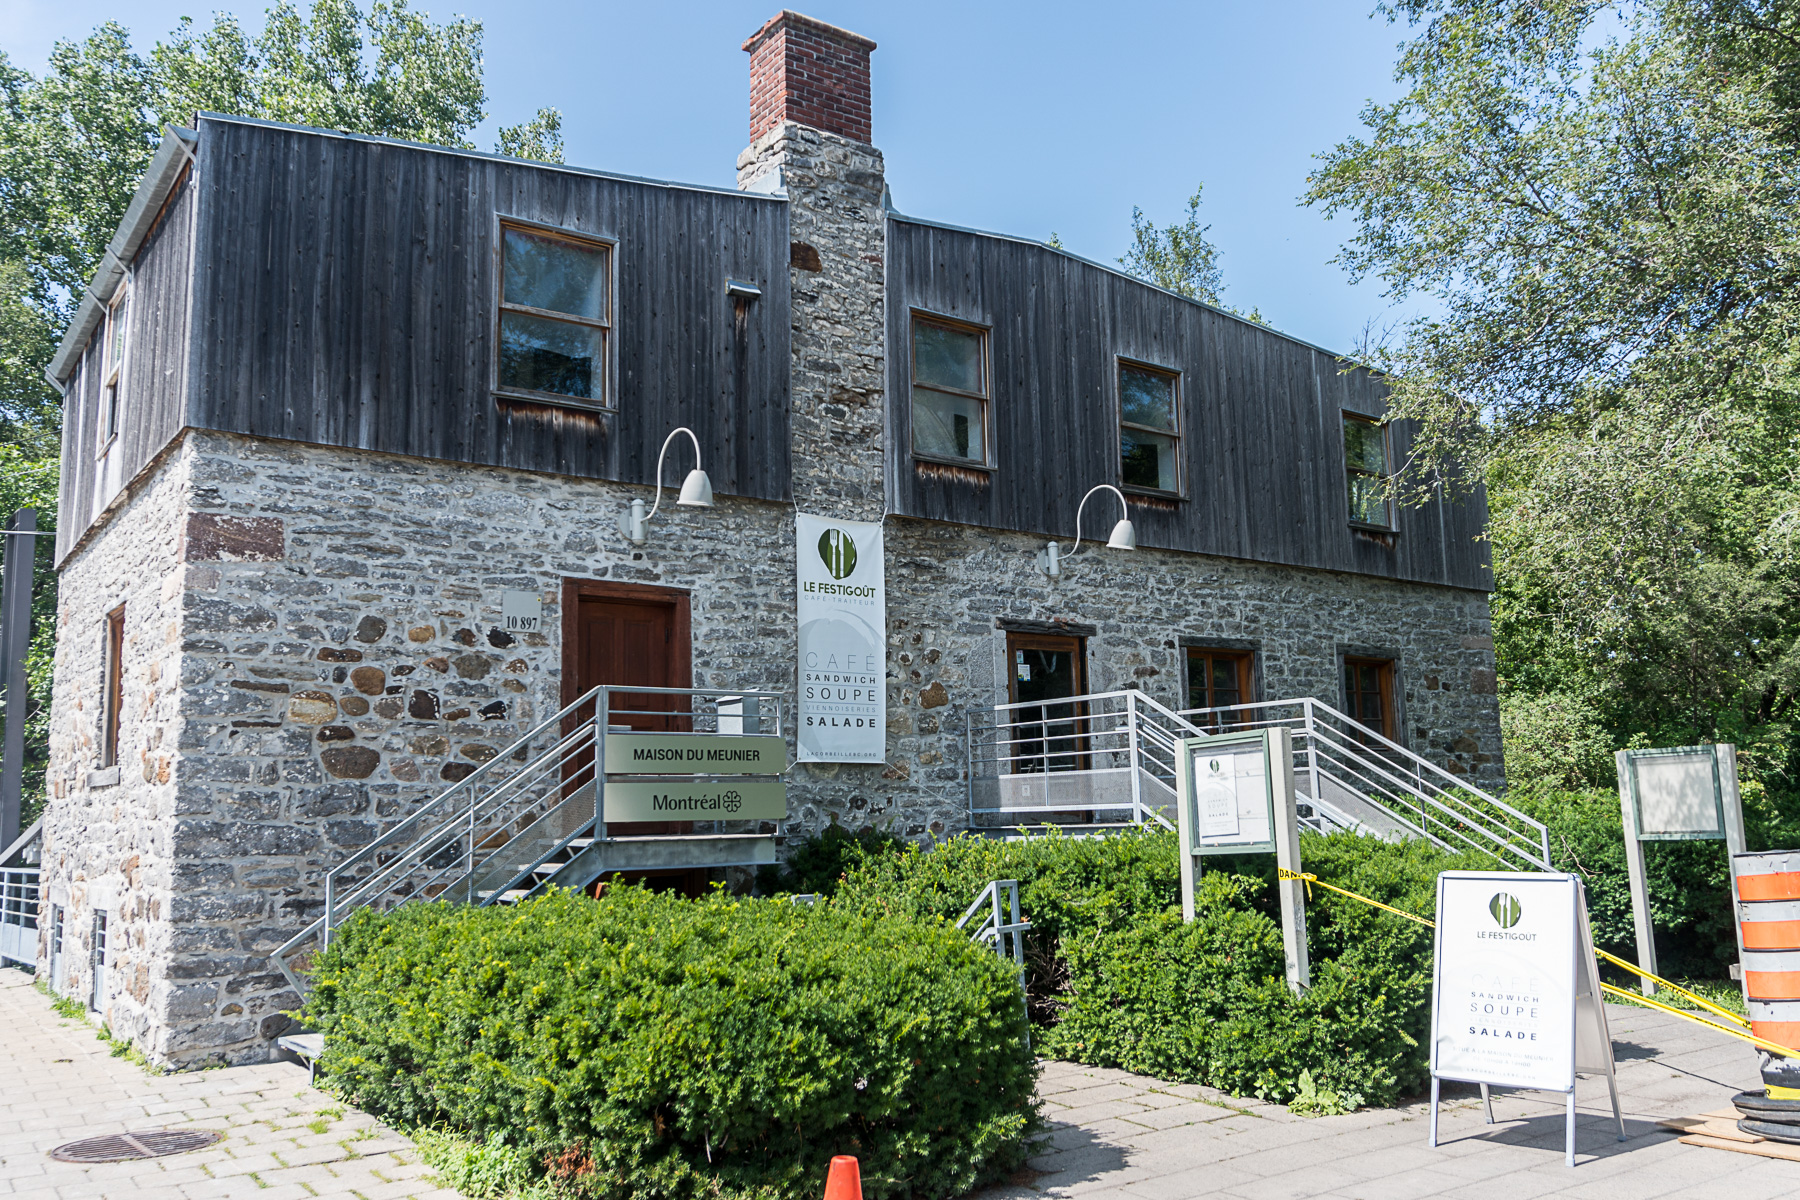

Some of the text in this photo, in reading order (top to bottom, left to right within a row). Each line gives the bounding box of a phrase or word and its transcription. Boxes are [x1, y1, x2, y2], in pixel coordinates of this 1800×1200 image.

[804, 581, 876, 598] LE FESTIGOÛT
[506, 616, 537, 630] 10 897
[805, 651, 875, 671] CAFÉ
[806, 673, 876, 684] SANDWICH
[806, 686, 876, 702] SOUPE
[806, 704, 876, 713] VIENNOISERIES
[806, 716, 876, 728] SALADE
[633, 749, 760, 761] MAISON DU MEUNIER
[653, 794, 721, 811] Montréal
[1477, 931, 1486, 939] LE
[1471, 991, 1539, 1003] SANDWICH
[1470, 1002, 1538, 1018] SOUPE
[1469, 1026, 1537, 1041] SALADE
